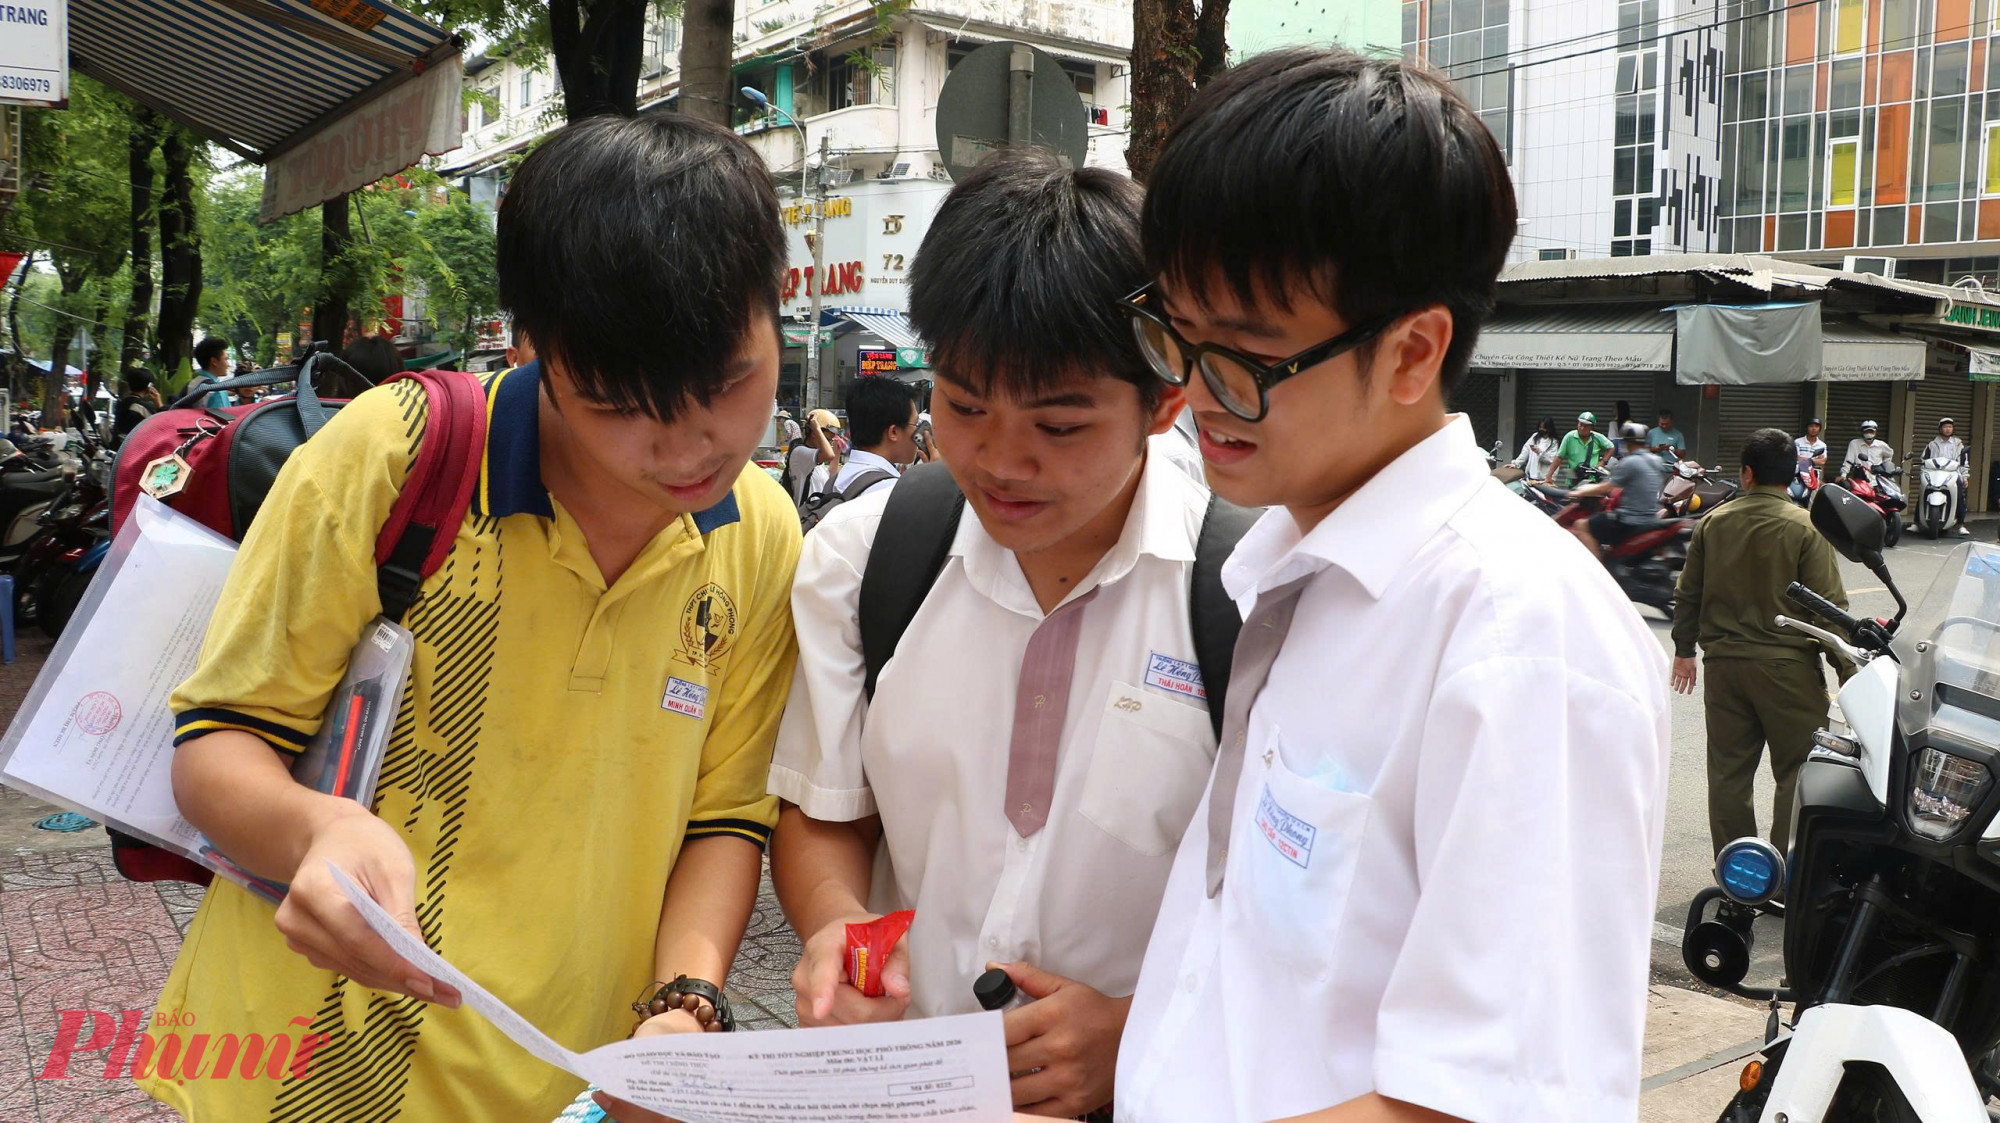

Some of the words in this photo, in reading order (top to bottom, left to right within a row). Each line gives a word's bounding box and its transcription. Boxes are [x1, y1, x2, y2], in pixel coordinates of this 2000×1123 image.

[0, 5, 48, 26] TRANG
[0, 75, 50, 93] 8306979
[882, 253, 904, 271] 72
[1501, 353, 1514, 361] Gia
[1515, 353, 1534, 362] Công
[1581, 354, 1603, 363] Trang
[1604, 354, 1624, 362] Theo
[686, 599, 696, 614] THPT
[727, 608, 737, 635] PHONG
[667, 700, 684, 711] MINH
[826, 1048, 854, 1057] TRUNG
[925, 1040, 945, 1049] NĂM
